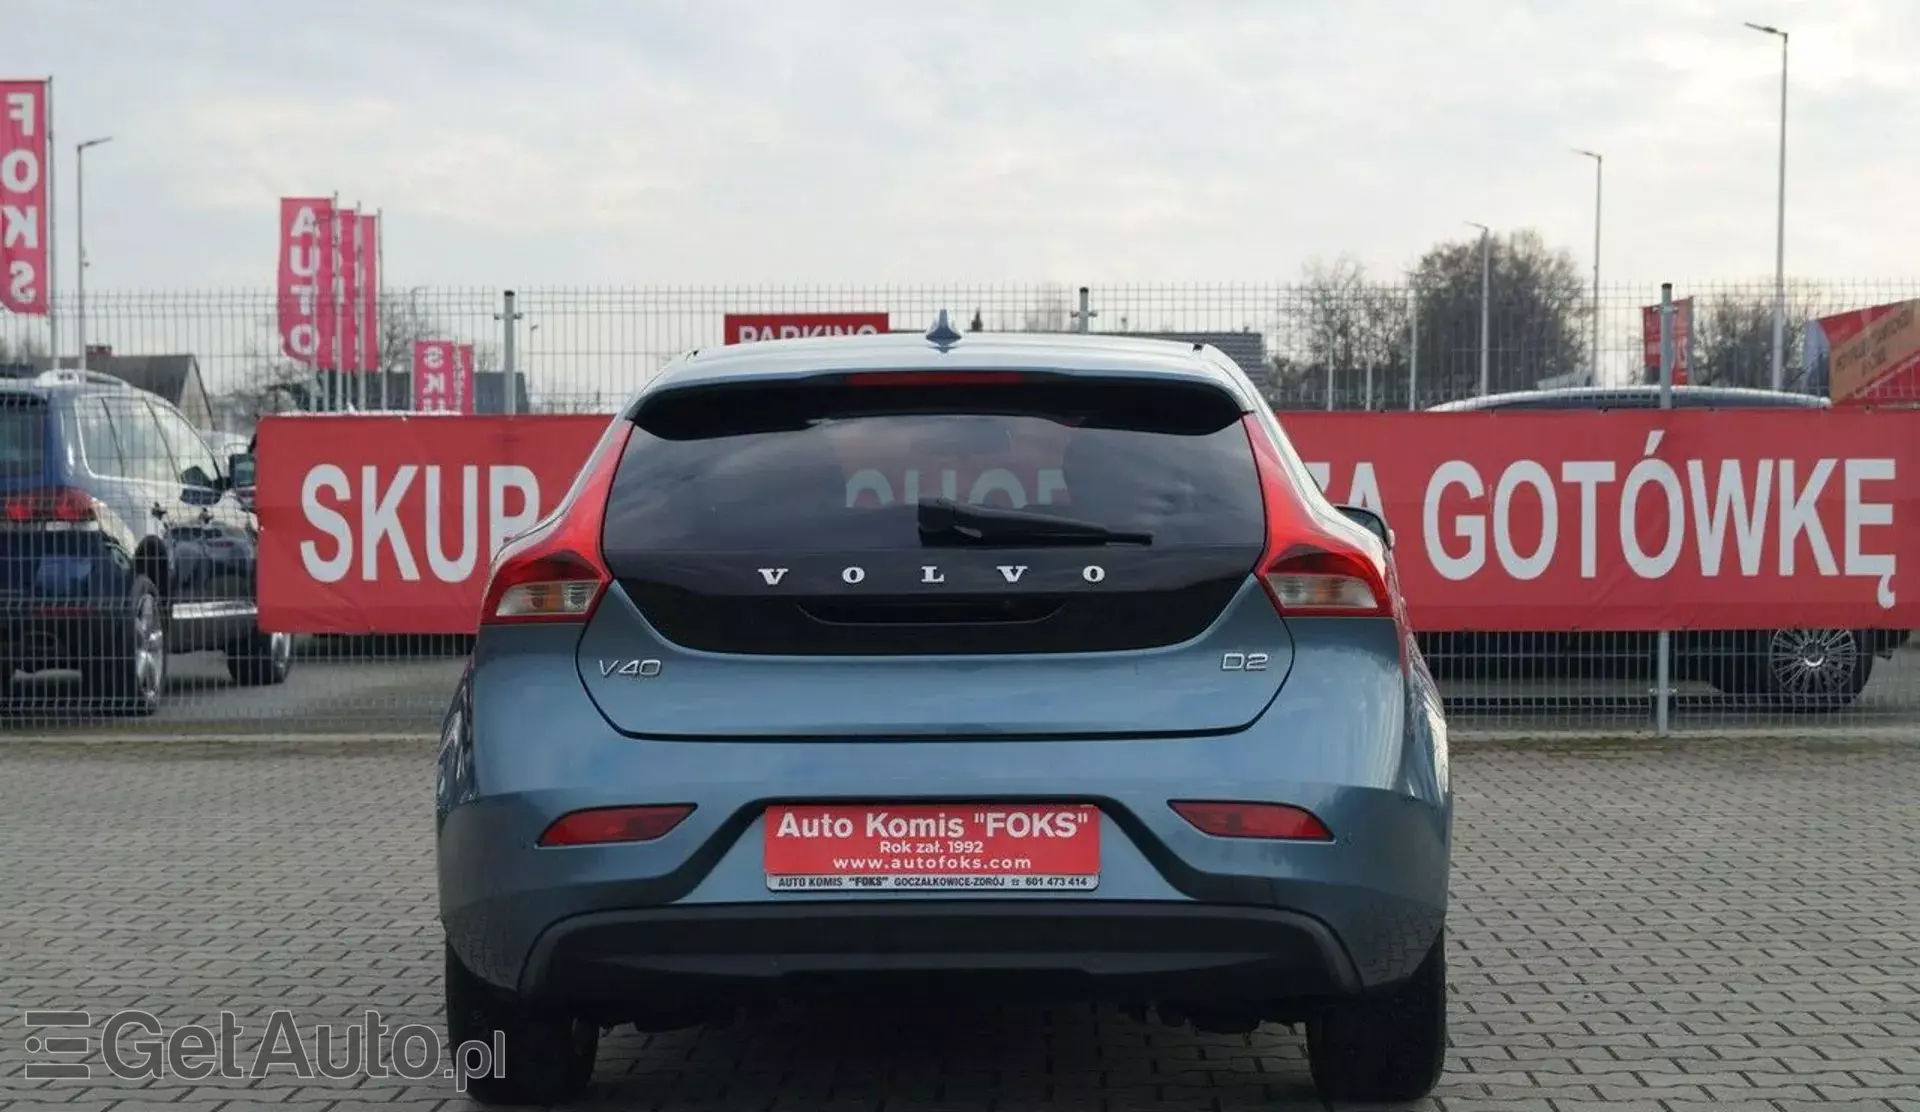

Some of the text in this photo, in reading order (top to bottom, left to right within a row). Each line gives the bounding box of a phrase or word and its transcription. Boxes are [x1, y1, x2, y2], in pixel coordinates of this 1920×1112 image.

[289, 205, 321, 356] AUTO
[300, 430, 1896, 608] SKUP GOTÓWKĘ
[758, 565, 1106, 585] VOLVO
[598, 659, 662, 676] V40
[1222, 652, 1269, 670] D2
[777, 811, 1088, 838] Auto Komis "FOKS"
[880, 841, 984, 854] Rok zał. 1992
[833, 856, 1031, 870] www.autofoks.com
[778, 877, 806, 888] AUTO
[809, 877, 843, 888] KOMIS
[850, 876, 889, 887] "FOKS"
[1026, 876, 1044, 887] 601
[1047, 876, 1066, 887] 473
[1068, 876, 1088, 887] 414
